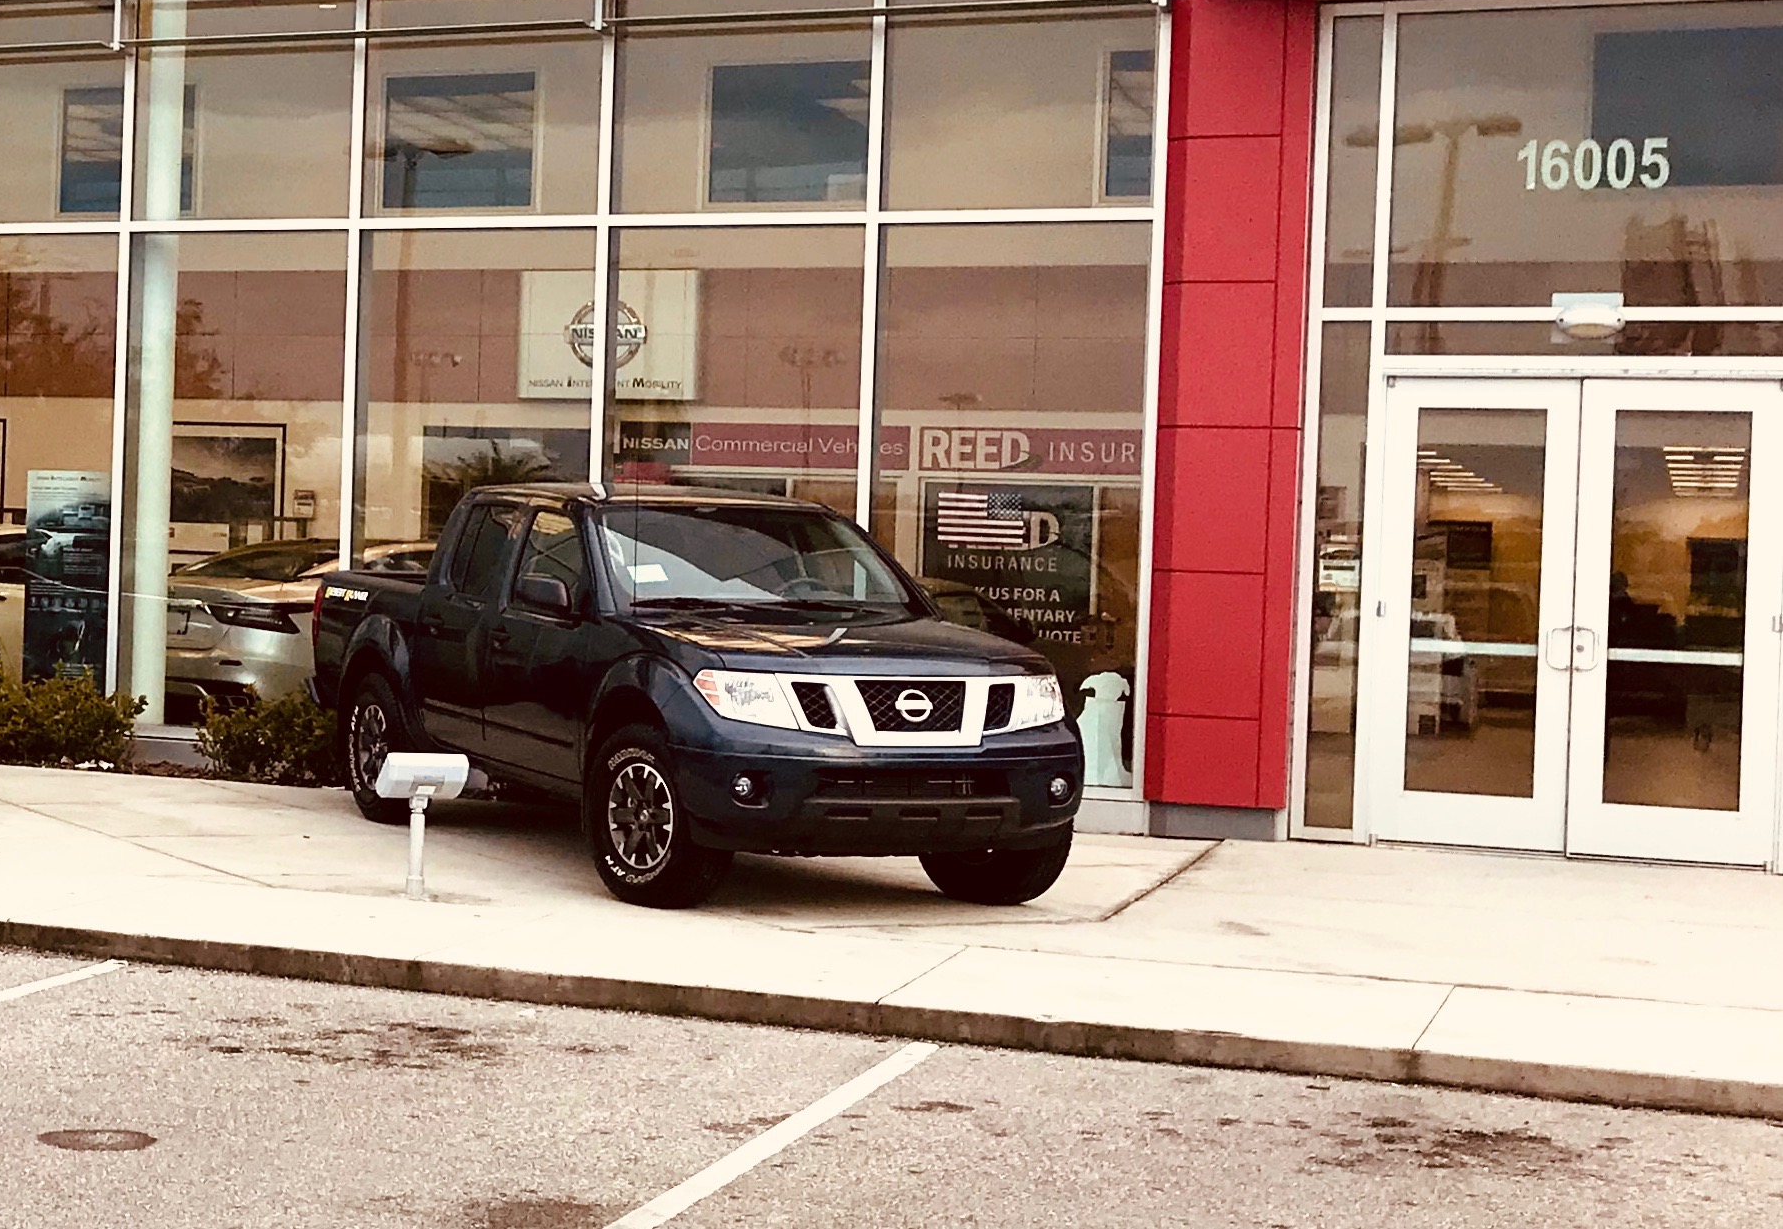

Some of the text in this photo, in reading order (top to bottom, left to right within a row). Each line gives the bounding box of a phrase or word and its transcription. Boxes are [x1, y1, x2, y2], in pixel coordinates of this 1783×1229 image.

[1517, 137, 1671, 191] 16005
[622, 430, 690, 451] NISSAN
[695, 434, 814, 454] Commercial
[921, 428, 1031, 470] REED
[947, 553, 1058, 572] INSURANCE
[988, 586, 1010, 601] US
[1013, 587, 1046, 602] FOR
[1048, 589, 1061, 603] A
